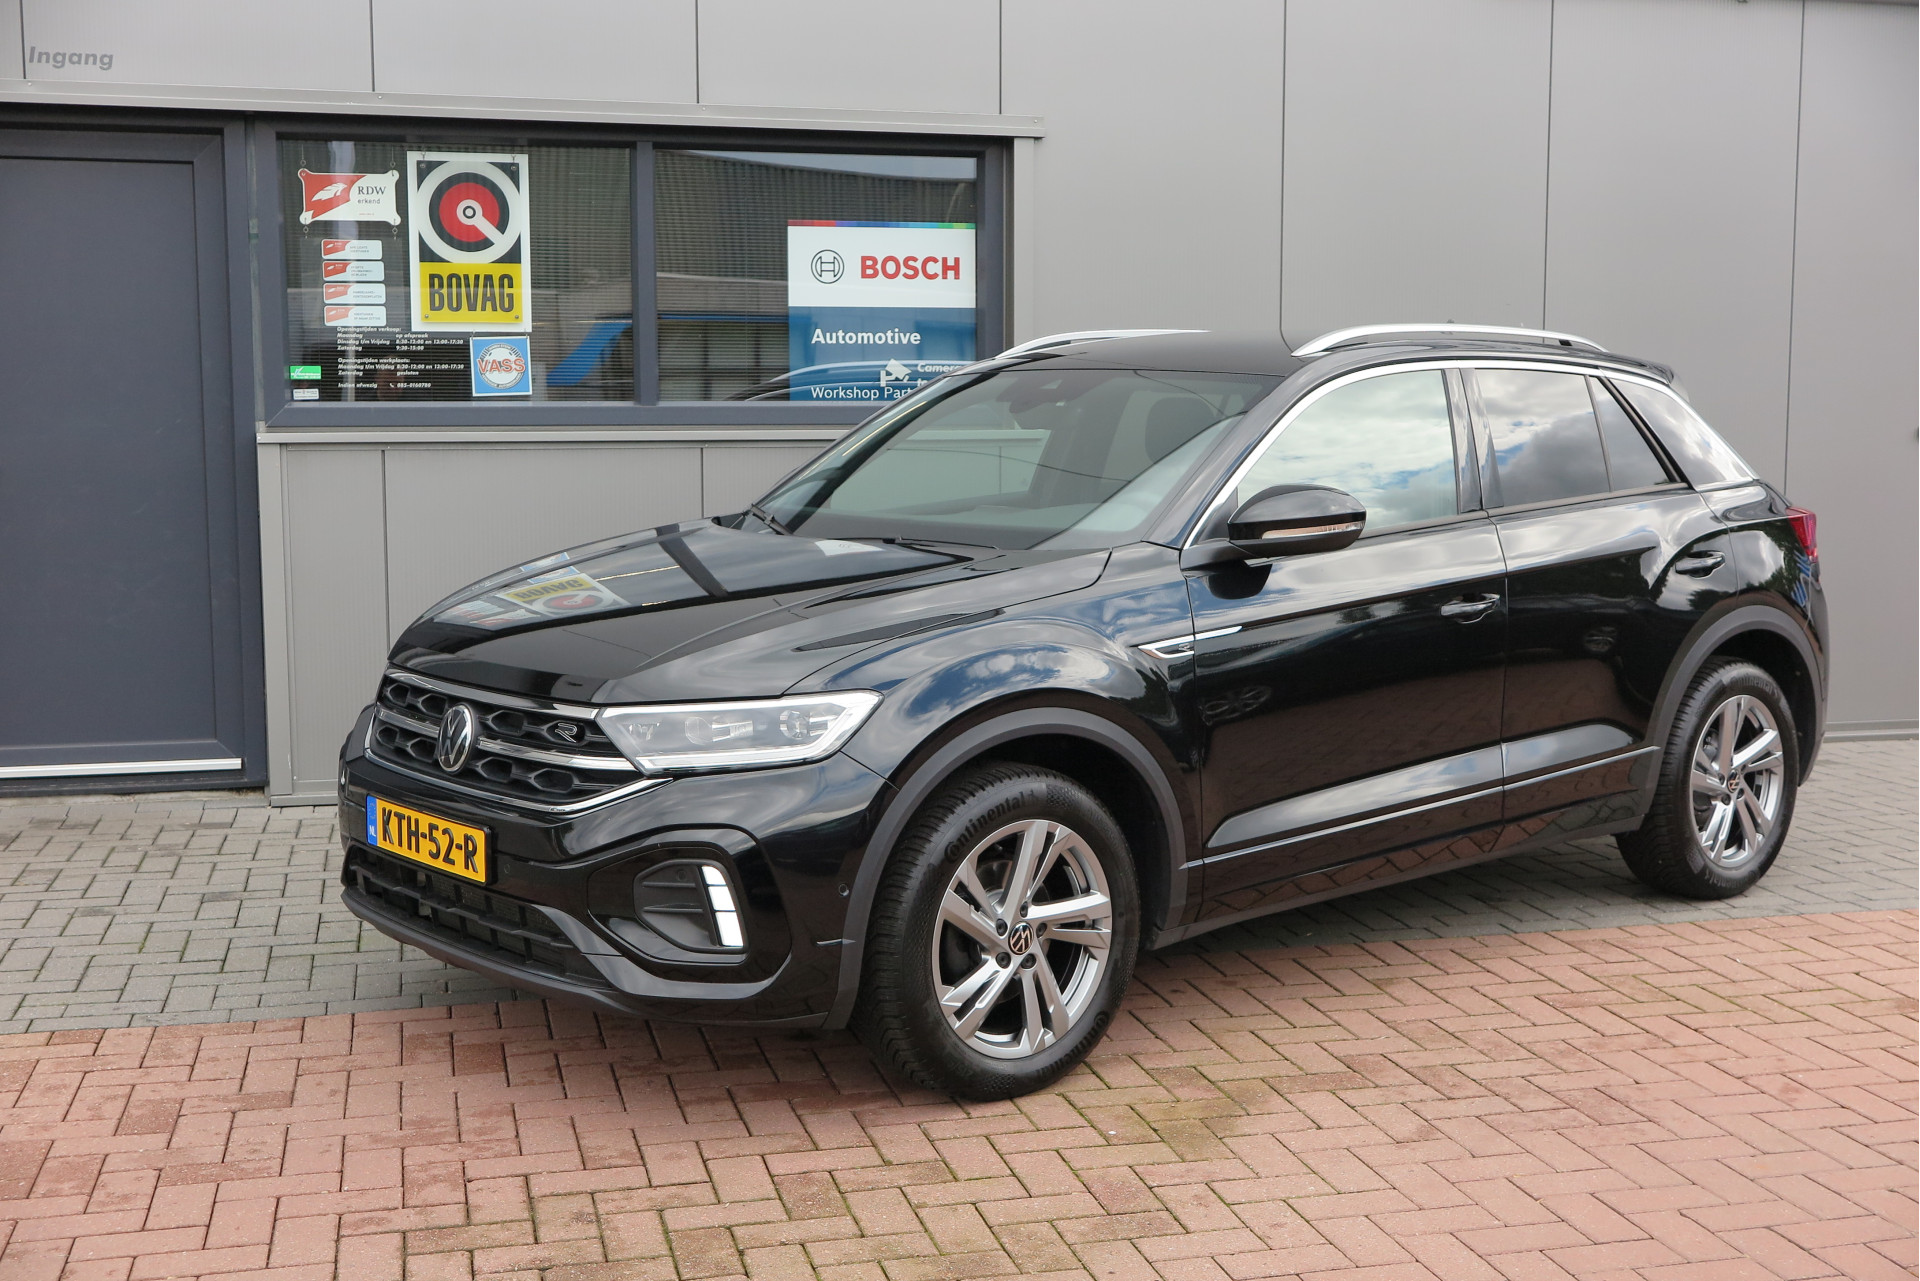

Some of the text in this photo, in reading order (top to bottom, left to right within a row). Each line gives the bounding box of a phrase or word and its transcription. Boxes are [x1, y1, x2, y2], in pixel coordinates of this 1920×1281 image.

[28, 46, 114, 71] Ingang
[357, 185, 387, 195] RDW
[860, 255, 961, 280] BOSCH
[428, 272, 515, 313] BOVAG
[811, 328, 921, 345] Automotive
[477, 358, 526, 373] VASS
[810, 386, 880, 401] Workshop
[369, 824, 377, 837] NL
[944, 791, 1026, 863] Continental
[381, 806, 479, 874] KTH-52-R
